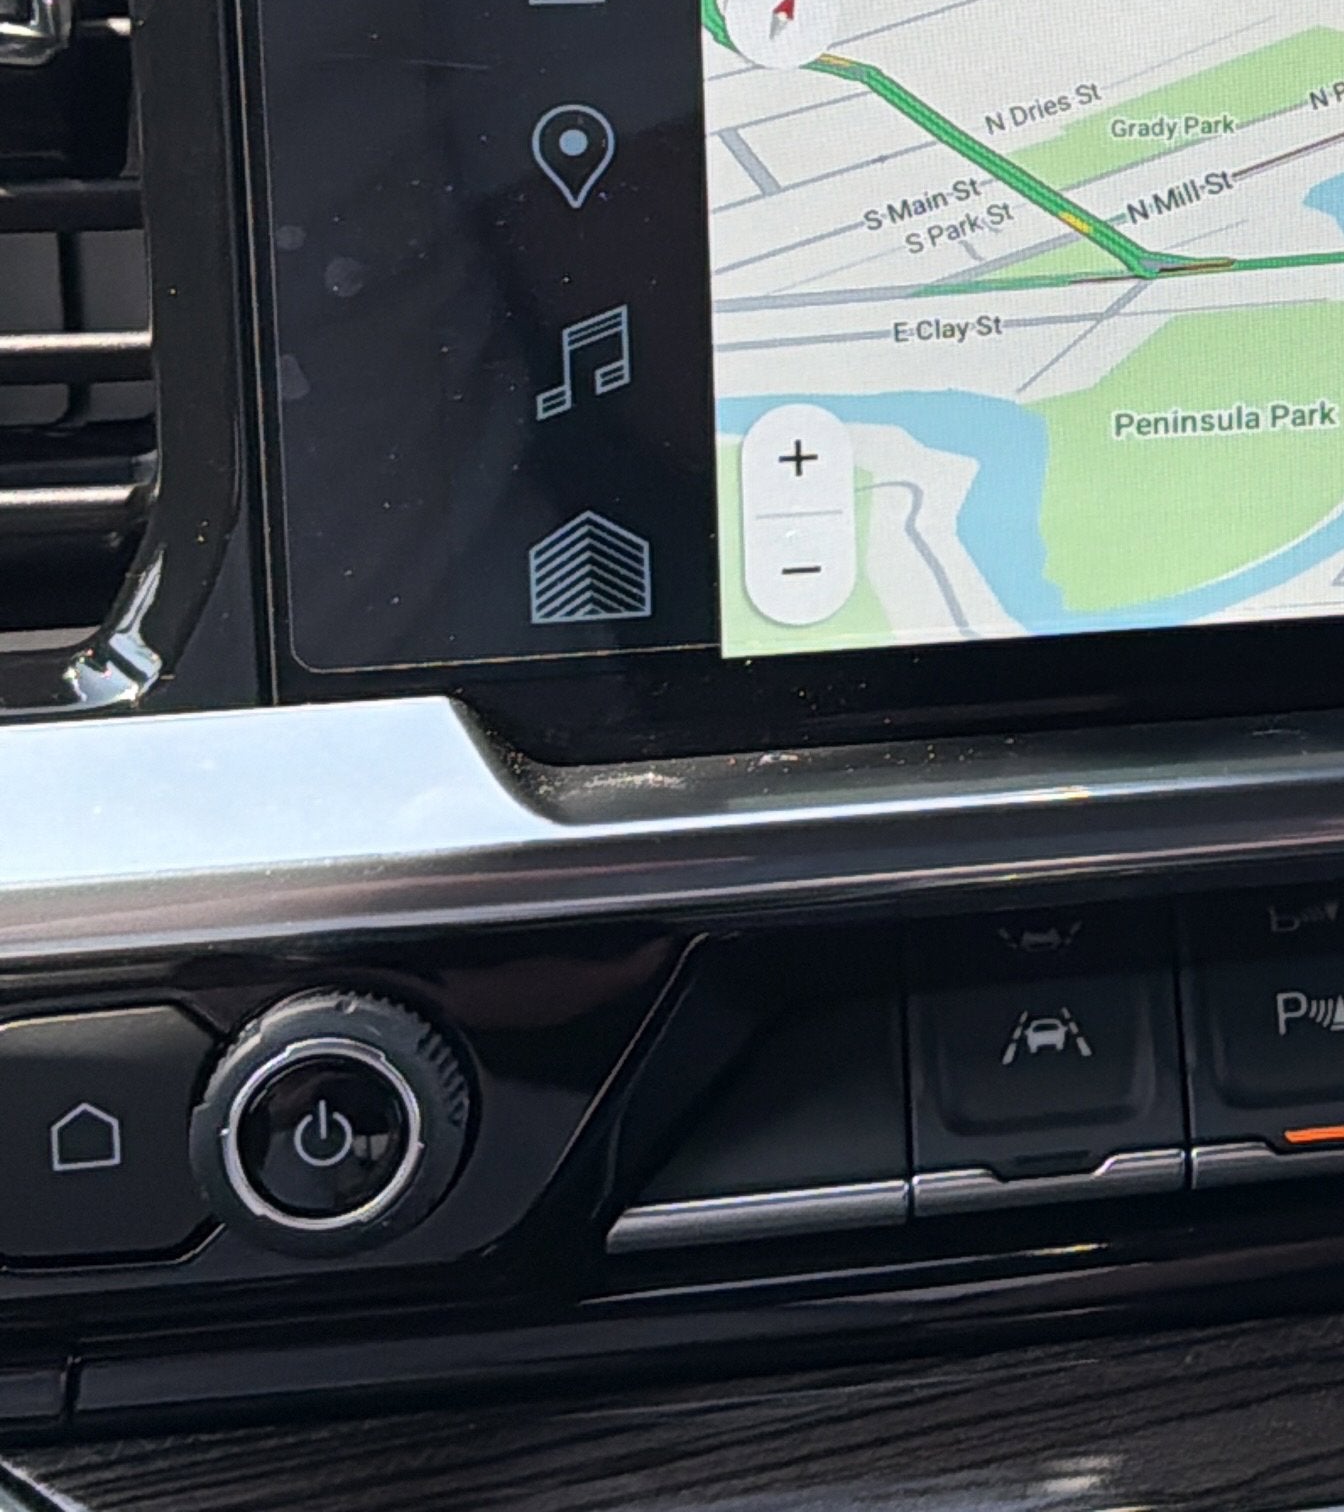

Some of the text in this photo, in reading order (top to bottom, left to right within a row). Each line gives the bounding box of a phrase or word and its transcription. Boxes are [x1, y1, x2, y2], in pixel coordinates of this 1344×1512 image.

[985, 82, 1102, 136] N Dries St
[1308, 88, 1331, 112] N
[1110, 114, 1236, 140] Grady Park
[865, 177, 982, 231] S Main St
[1126, 170, 1234, 224] N Mill St
[905, 201, 1016, 255] S Park St
[892, 314, 1004, 346] E Clay St
[1113, 401, 1337, 437] Peninsula Park
[1275, 990, 1307, 1035] P
